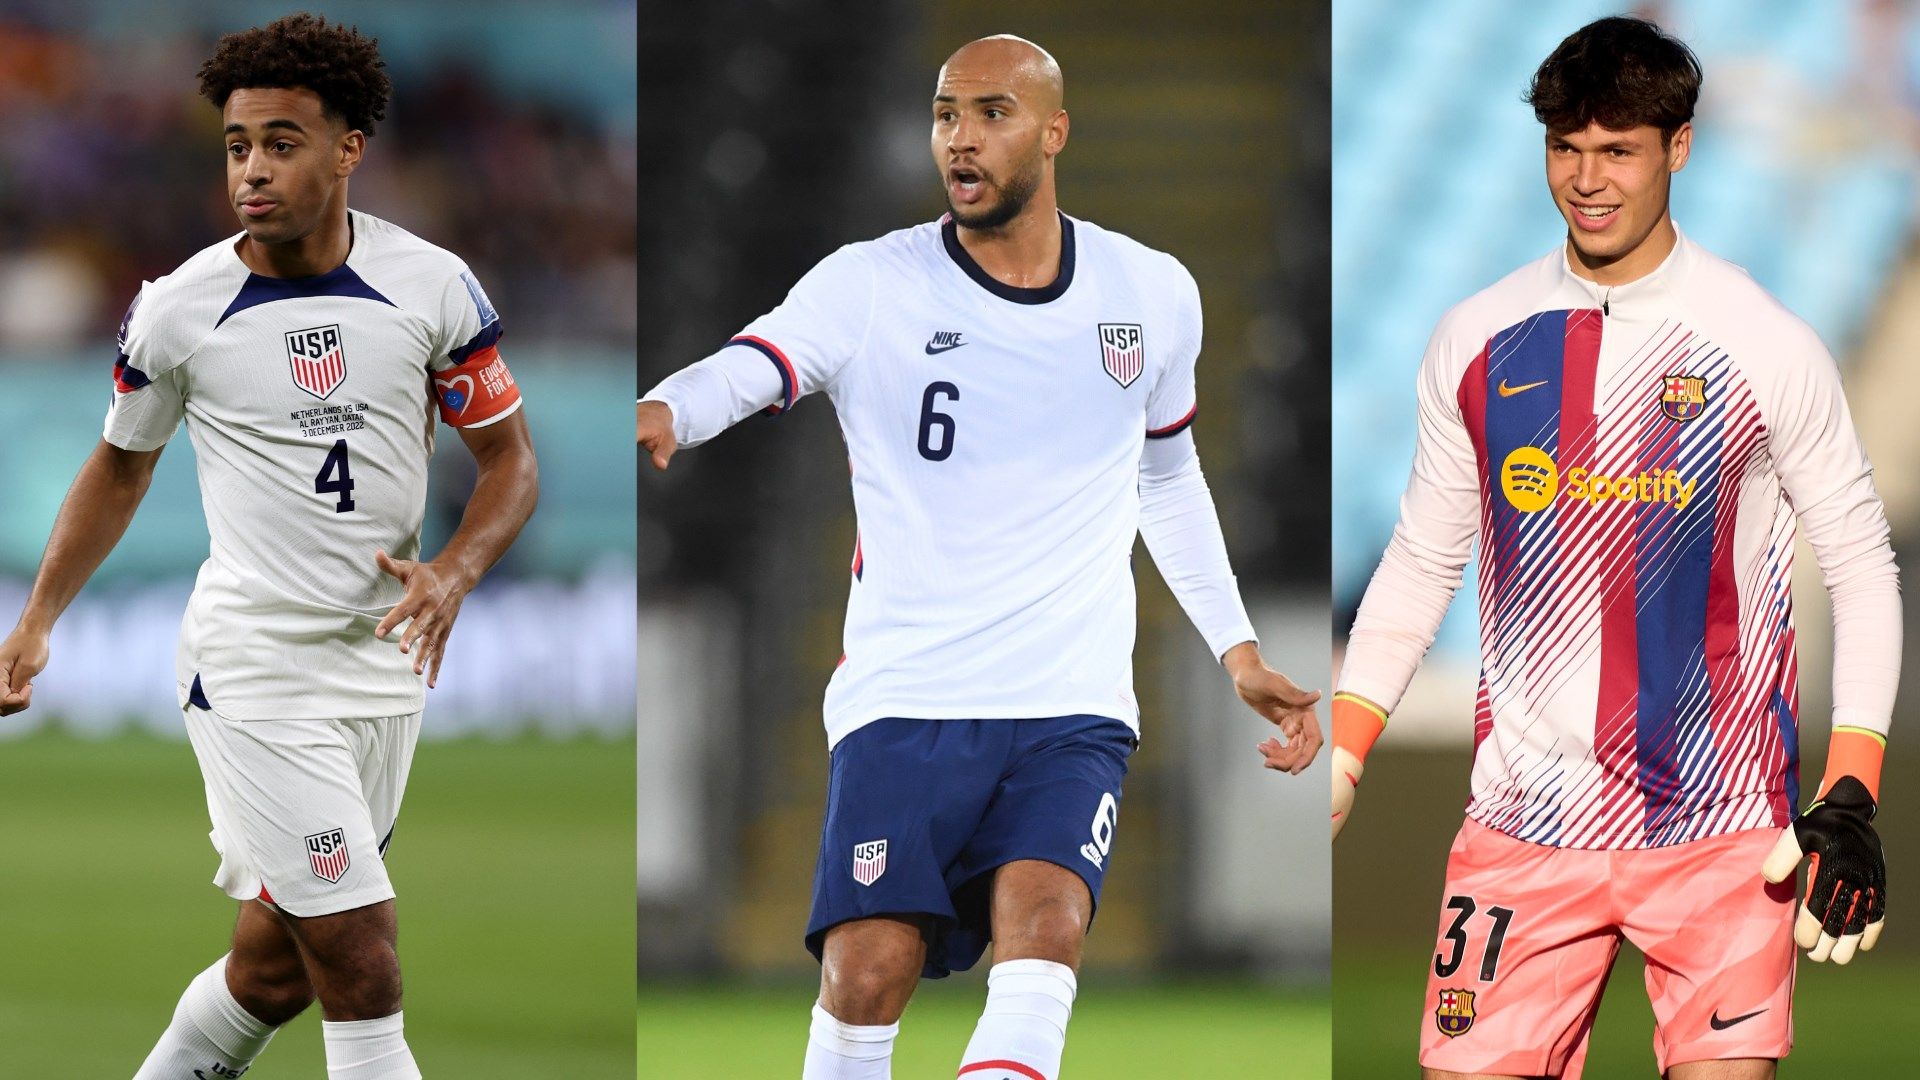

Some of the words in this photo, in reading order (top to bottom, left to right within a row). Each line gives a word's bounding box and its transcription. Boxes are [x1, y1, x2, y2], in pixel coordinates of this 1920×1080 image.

[290, 329, 337, 359] USA
[931, 331, 963, 346] NIKE
[1104, 328, 1139, 350] USA
[486, 378, 507, 399] FOR
[290, 405, 342, 420] NETHERLANDS
[344, 404, 353, 413] VS
[355, 403, 369, 412] USA
[299, 419, 308, 429] AL
[341, 413, 365, 422] QATAR
[917, 381, 960, 462] 6
[301, 429, 308, 438] 3
[309, 423, 345, 437] DECEMBER
[346, 421, 365, 431] 2022
[314, 438, 355, 514] 4
[1567, 467, 1698, 509] Spotify
[1091, 792, 1117, 857] 6
[308, 832, 342, 854] USA
[856, 842, 885, 861] USA
[1435, 895, 1515, 982] 31
